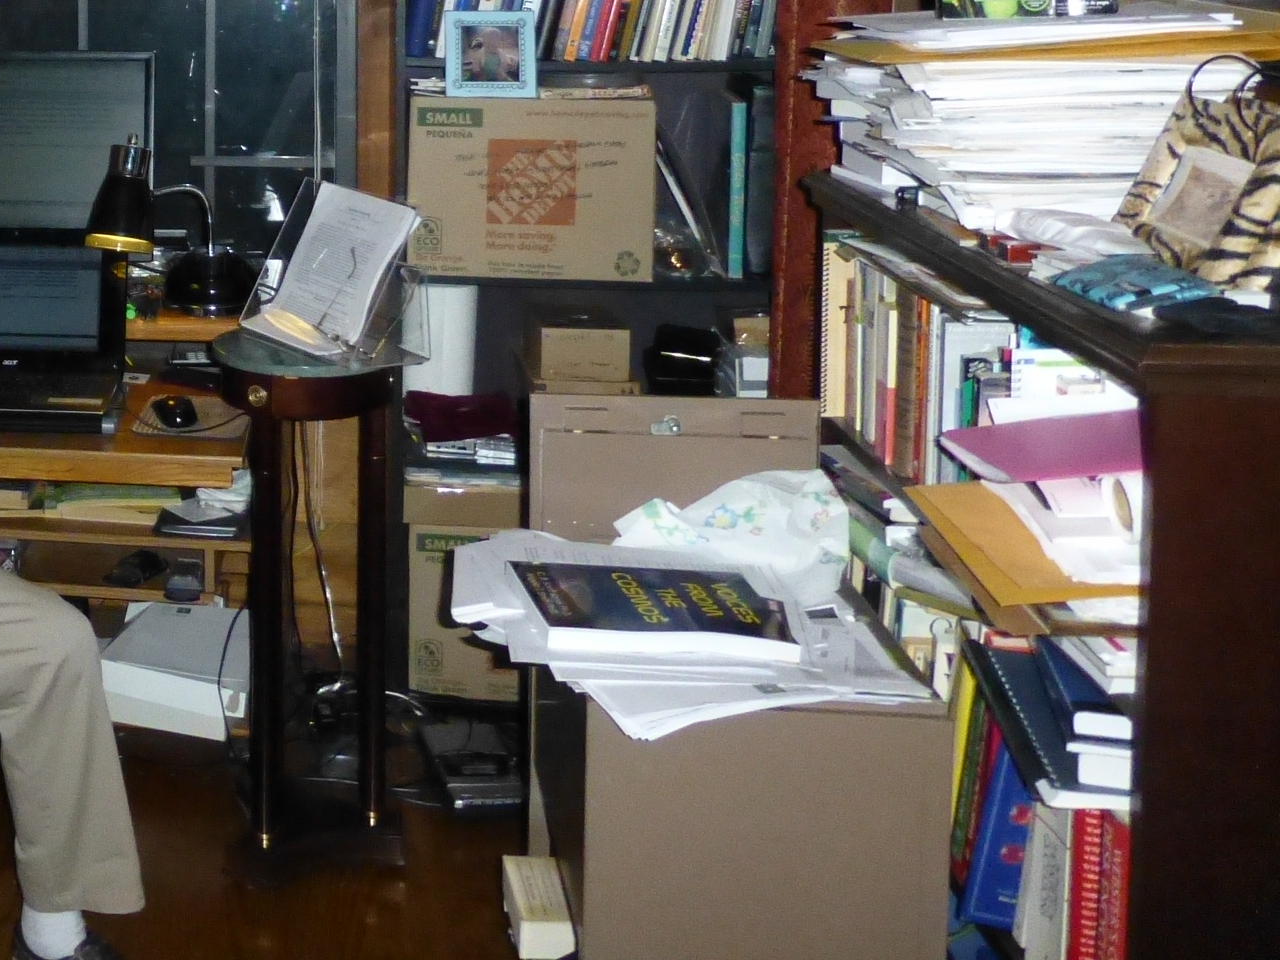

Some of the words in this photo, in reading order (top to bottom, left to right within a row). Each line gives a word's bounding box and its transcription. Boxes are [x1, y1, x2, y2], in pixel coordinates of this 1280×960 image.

[425, 112, 472, 124] SMALL
[426, 129, 473, 139] PEQUEÑA
[416, 237, 439, 246] ECO
[486, 231, 516, 239] More
[518, 232, 557, 242] saving.
[486, 242, 515, 251] More
[611, 572, 670, 624] COSMOS
[654, 588, 687, 608] THE
[680, 582, 725, 617] FROM
[710, 583, 762, 625] VOICES
